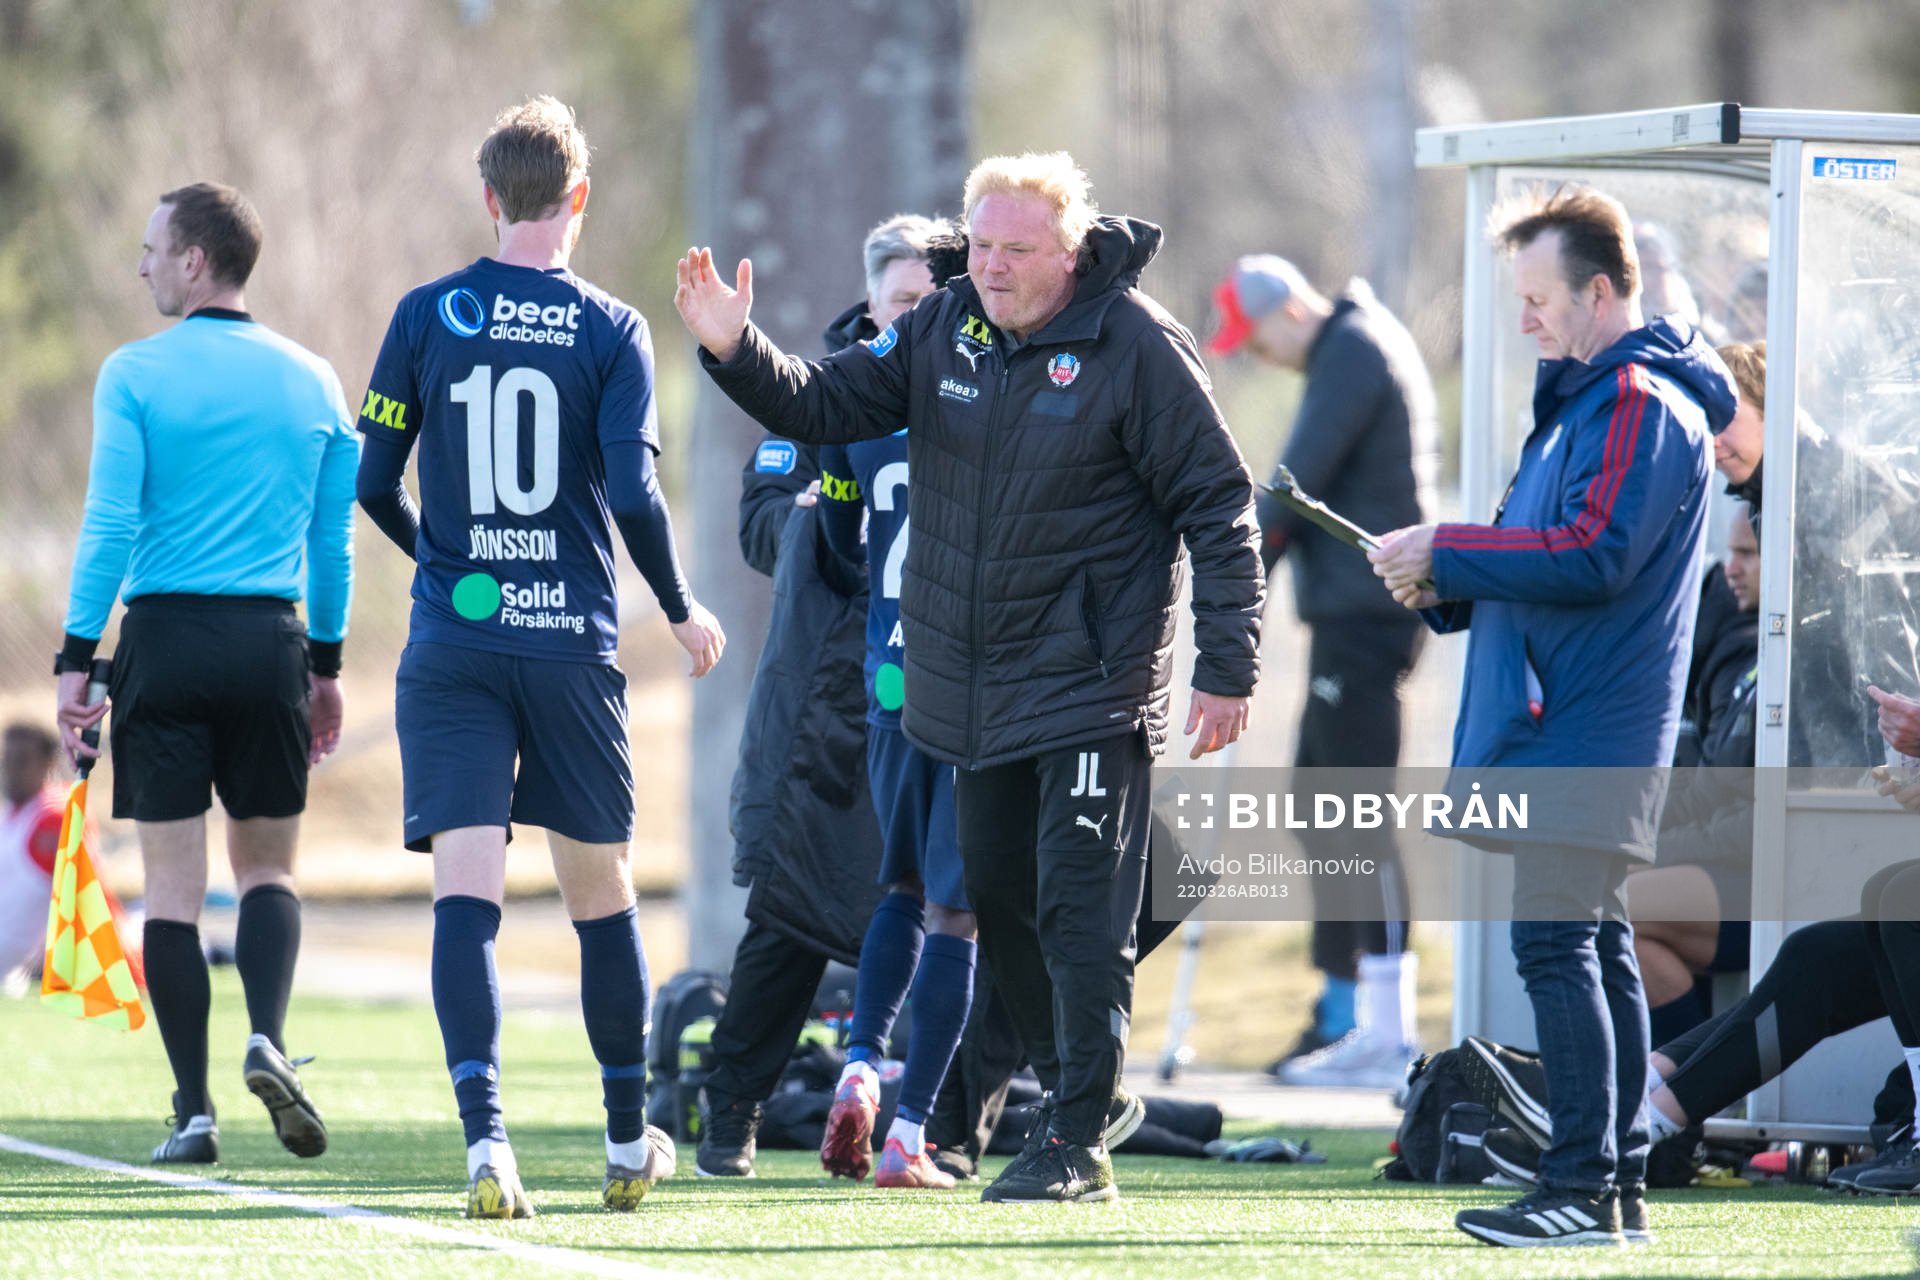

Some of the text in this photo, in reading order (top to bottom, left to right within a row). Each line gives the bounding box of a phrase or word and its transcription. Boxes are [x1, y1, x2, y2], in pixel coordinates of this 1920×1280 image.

[1824, 159, 1896, 180] ÖSTER
[492, 294, 581, 330] beat
[489, 324, 575, 347] diabetes
[960, 314, 992, 345] XX
[361, 389, 407, 431] XXL
[450, 365, 559, 516] 10
[821, 470, 860, 502] XXL
[469, 524, 557, 561] JÖNSSON
[501, 582, 566, 608] Solid
[501, 607, 585, 634] Försäkring
[1070, 752, 1107, 797] JL
